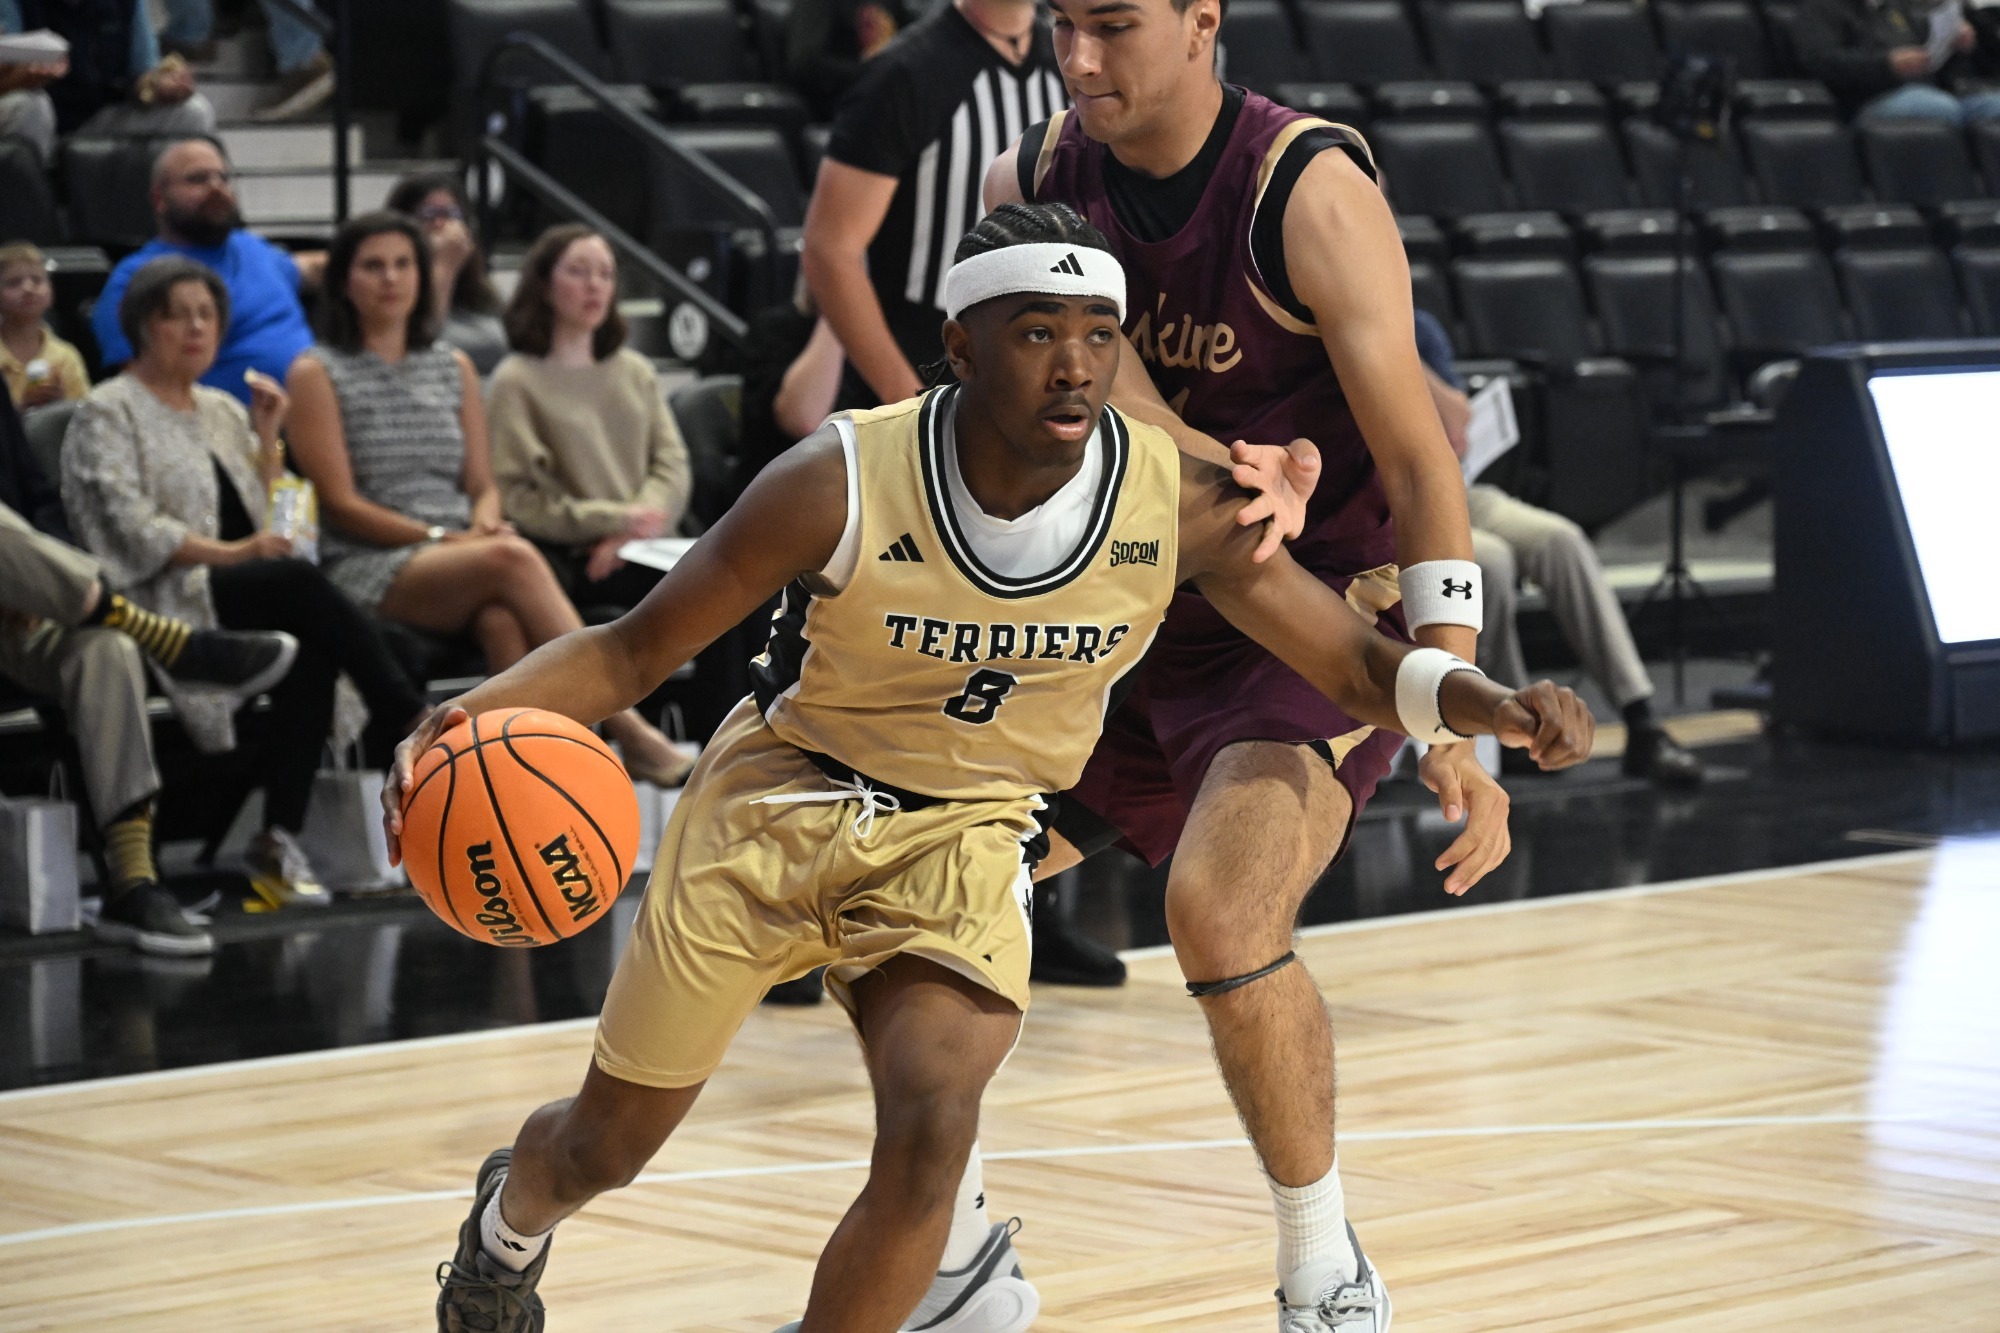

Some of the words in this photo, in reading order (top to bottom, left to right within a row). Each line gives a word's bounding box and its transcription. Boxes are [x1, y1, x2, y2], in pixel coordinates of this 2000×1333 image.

[1129, 292, 1243, 374] skine
[884, 612, 1130, 664] TERRIERS
[941, 666, 1020, 725] 8
[538, 833, 600, 922] NCAA
